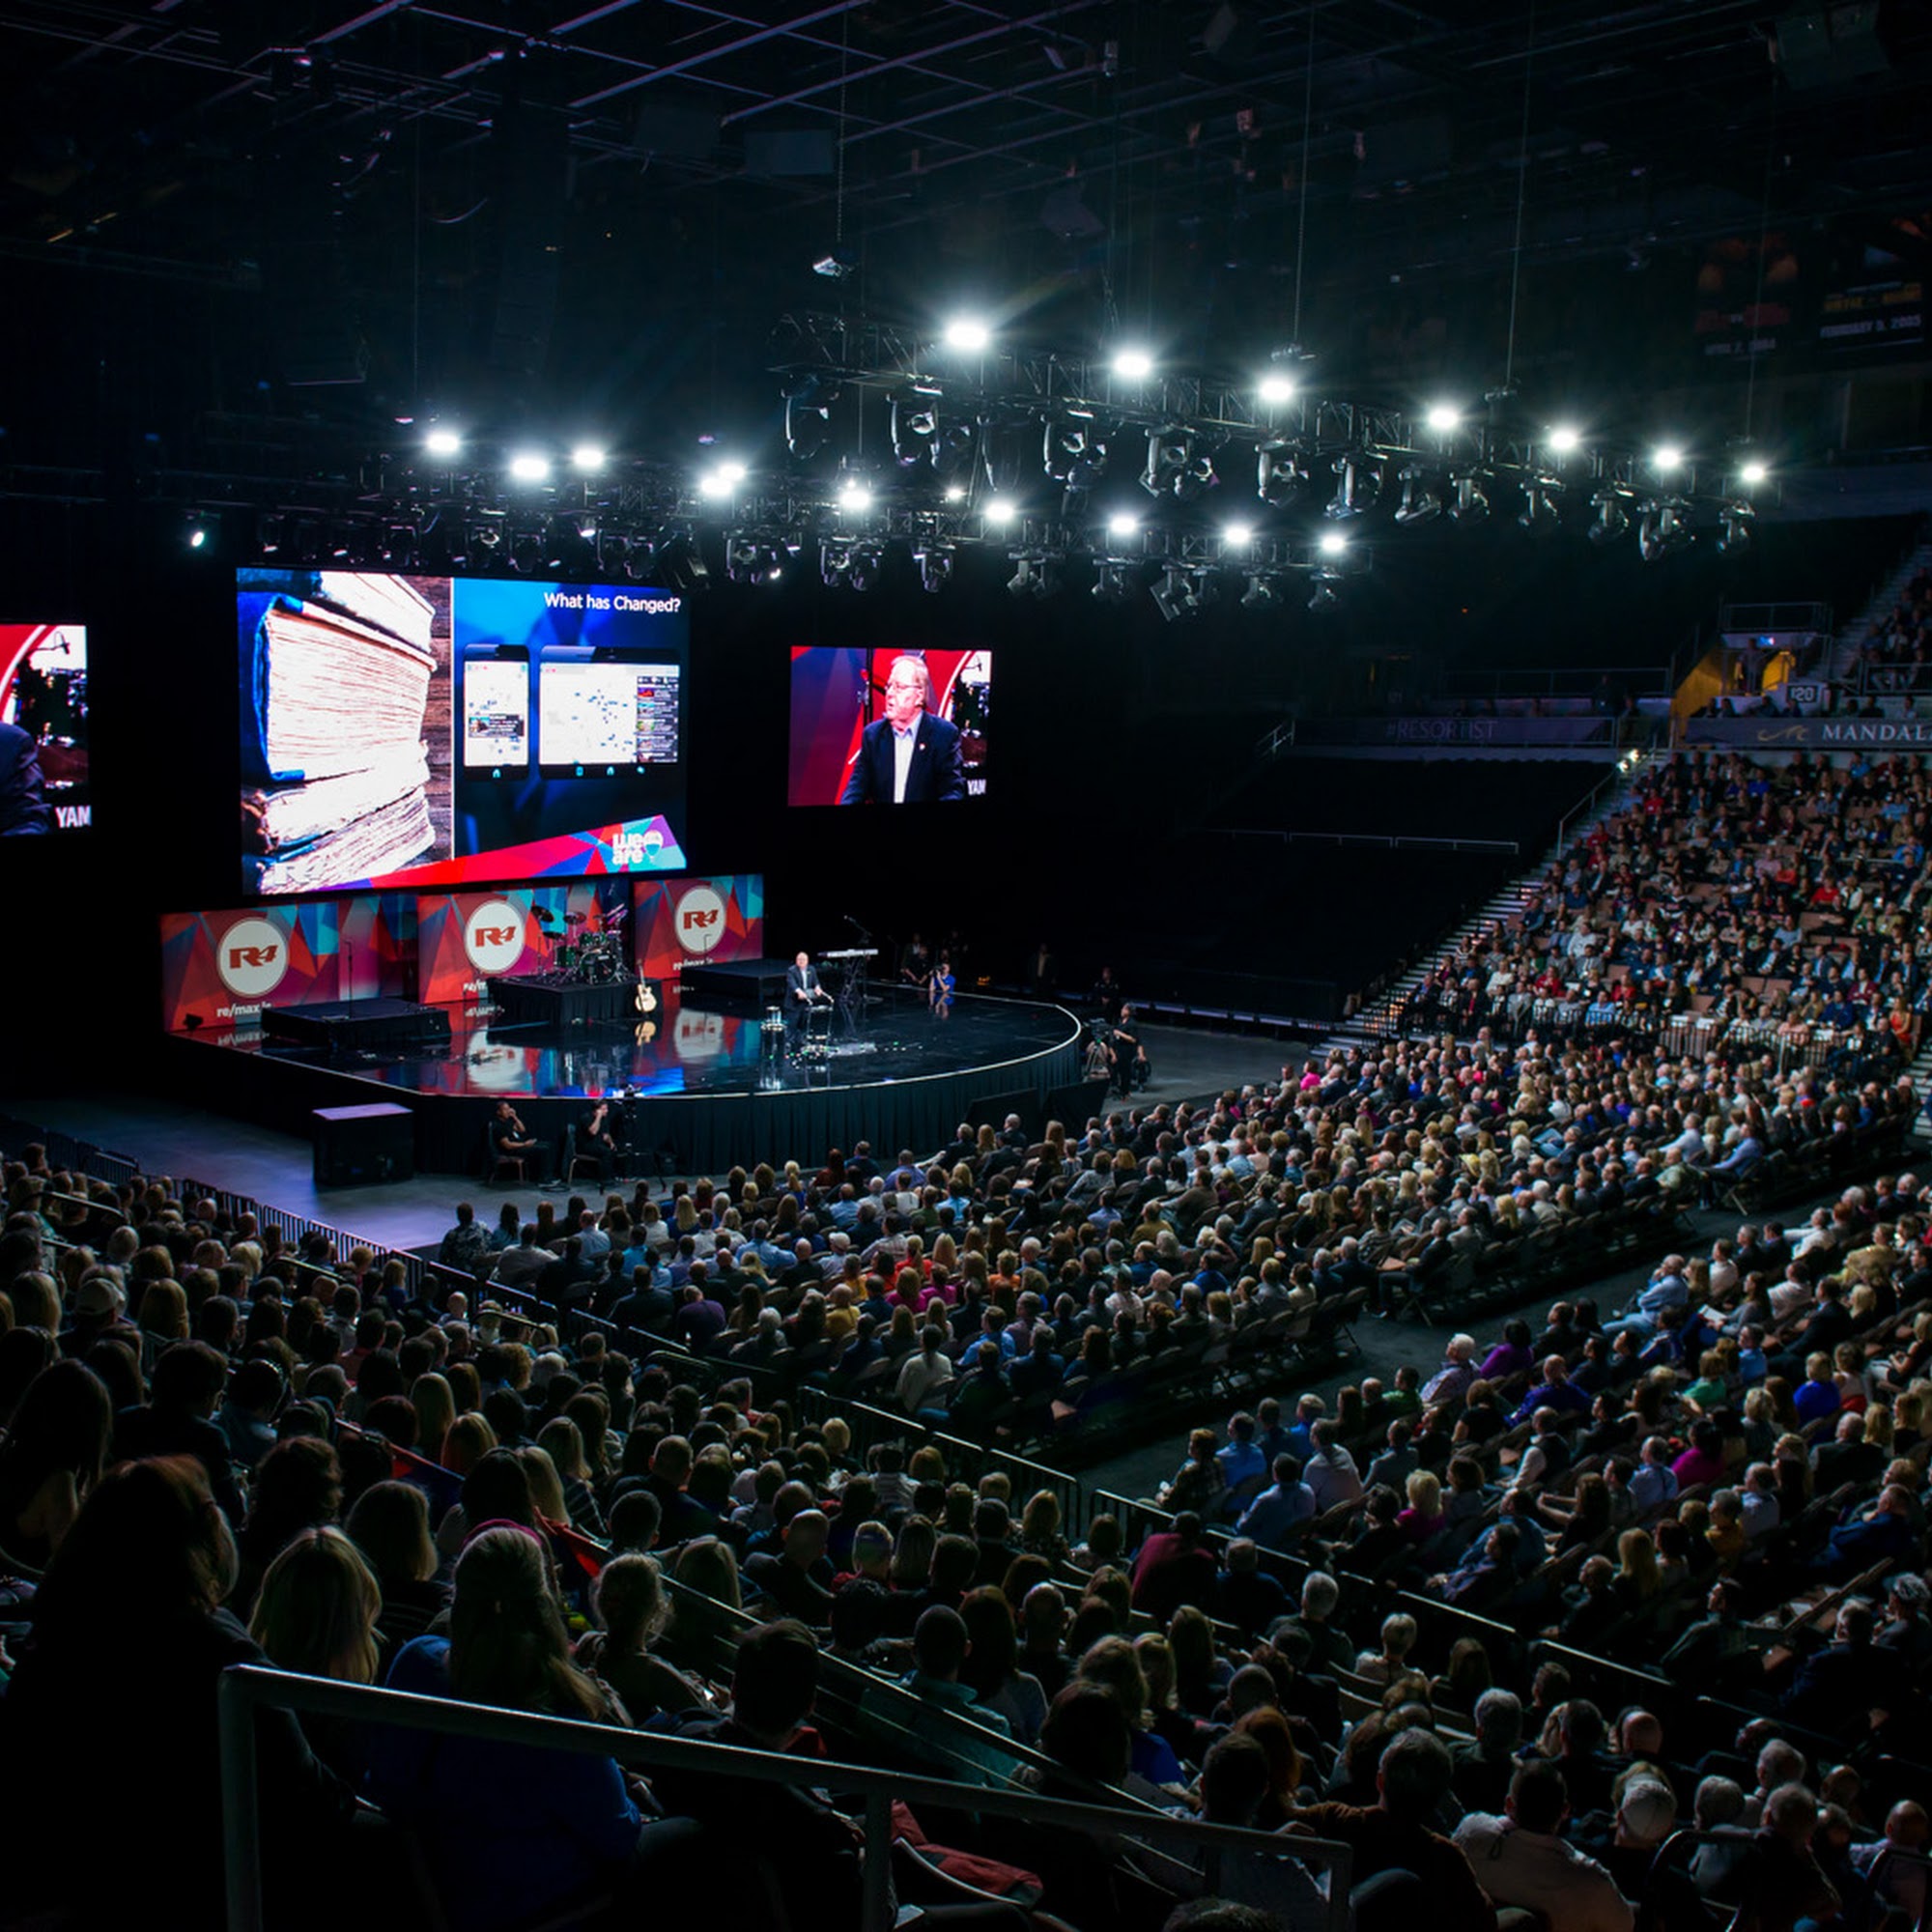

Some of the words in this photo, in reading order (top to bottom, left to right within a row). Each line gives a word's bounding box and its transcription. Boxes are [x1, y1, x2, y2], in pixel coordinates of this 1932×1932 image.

[544, 592, 583, 609] What
[586, 594, 611, 610] has
[613, 595, 681, 614] Changed?
[1790, 686, 1815, 701] 120
[1384, 719, 1498, 741] #RESORTIST
[1822, 724, 1932, 742] MANDAL
[612, 833, 644, 848] we
[611, 847, 643, 866] are
[683, 909, 719, 929] R4
[474, 925, 517, 948] R4
[229, 945, 278, 969] R4
[216, 1003, 261, 1017] re/max
